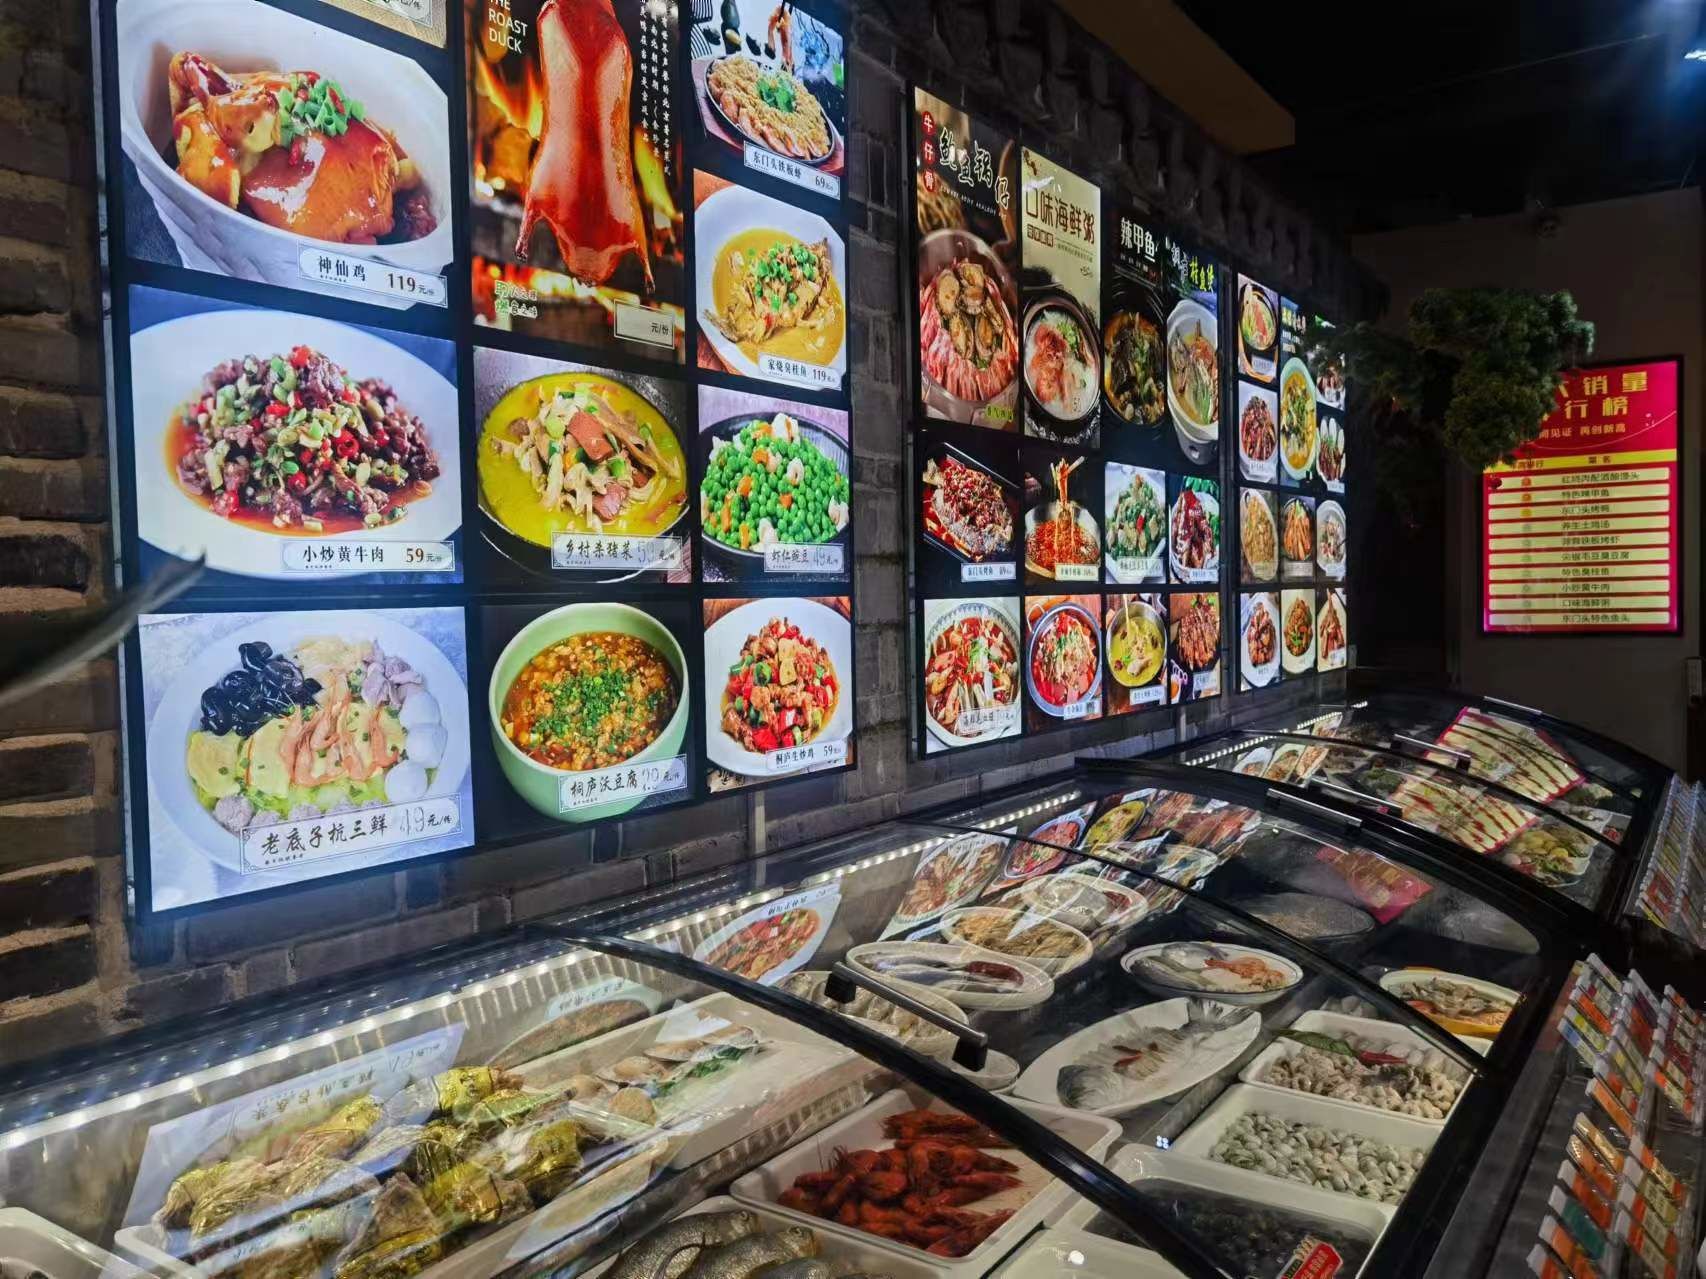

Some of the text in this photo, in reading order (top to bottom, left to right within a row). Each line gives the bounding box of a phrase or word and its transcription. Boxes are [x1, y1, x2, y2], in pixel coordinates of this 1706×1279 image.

[488, 8, 528, 37] ROAST
[488, 27, 522, 54] DUCK
[1026, 187, 1095, 244] 口味海鲜粥
[1121, 217, 1156, 263] 辣甲鱼
[318, 256, 366, 282] 神仙鸡
[651, 322, 669, 336] 元/份
[302, 545, 384, 563] 小炒黄牛肉
[566, 540, 633, 561] 乡村杀猪菜
[570, 769, 638, 798] 桐庐沃豆腐
[261, 814, 388, 856] 老底子杭三鲜
